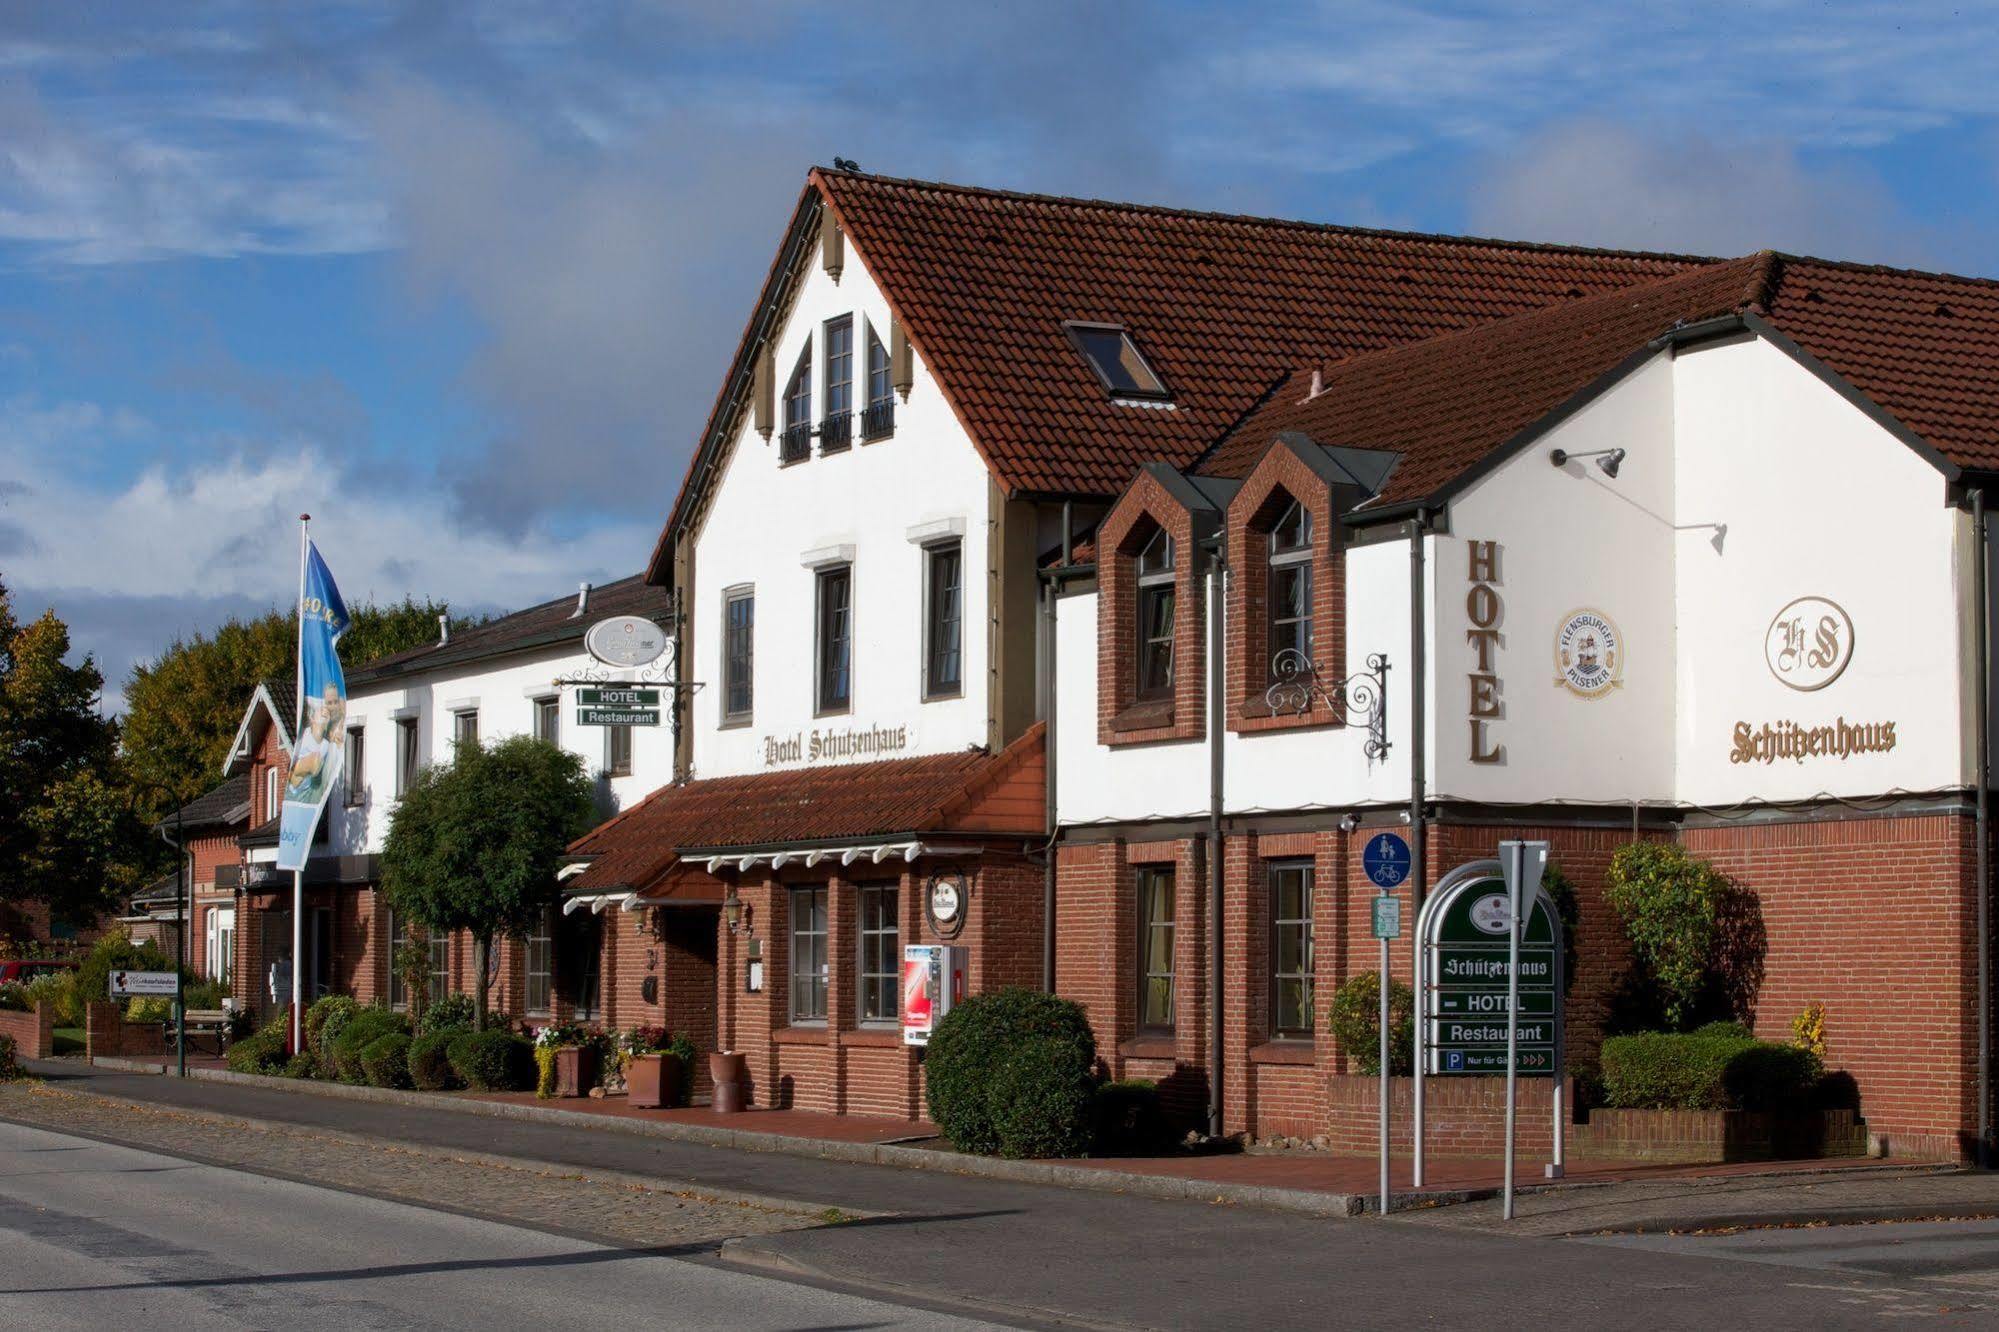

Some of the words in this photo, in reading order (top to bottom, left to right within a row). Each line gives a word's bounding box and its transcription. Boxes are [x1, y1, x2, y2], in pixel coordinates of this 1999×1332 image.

[1561, 616, 1615, 648] FLENSBURGER
[1466, 540, 1500, 763] HOTEL
[1567, 668, 1610, 689] PILSENER
[600, 692, 641, 702] HOTEL
[588, 711, 654, 723] Restaurant
[764, 732, 802, 768] Hotel
[1730, 716, 1897, 765] Schützenhaus
[1444, 959, 1547, 978] Schützenaus
[1451, 1025, 1542, 1041] Restauant
[1450, 1054, 1460, 1068] P
[1467, 1056, 1481, 1065] Nur
[1483, 1056, 1494, 1065] für
